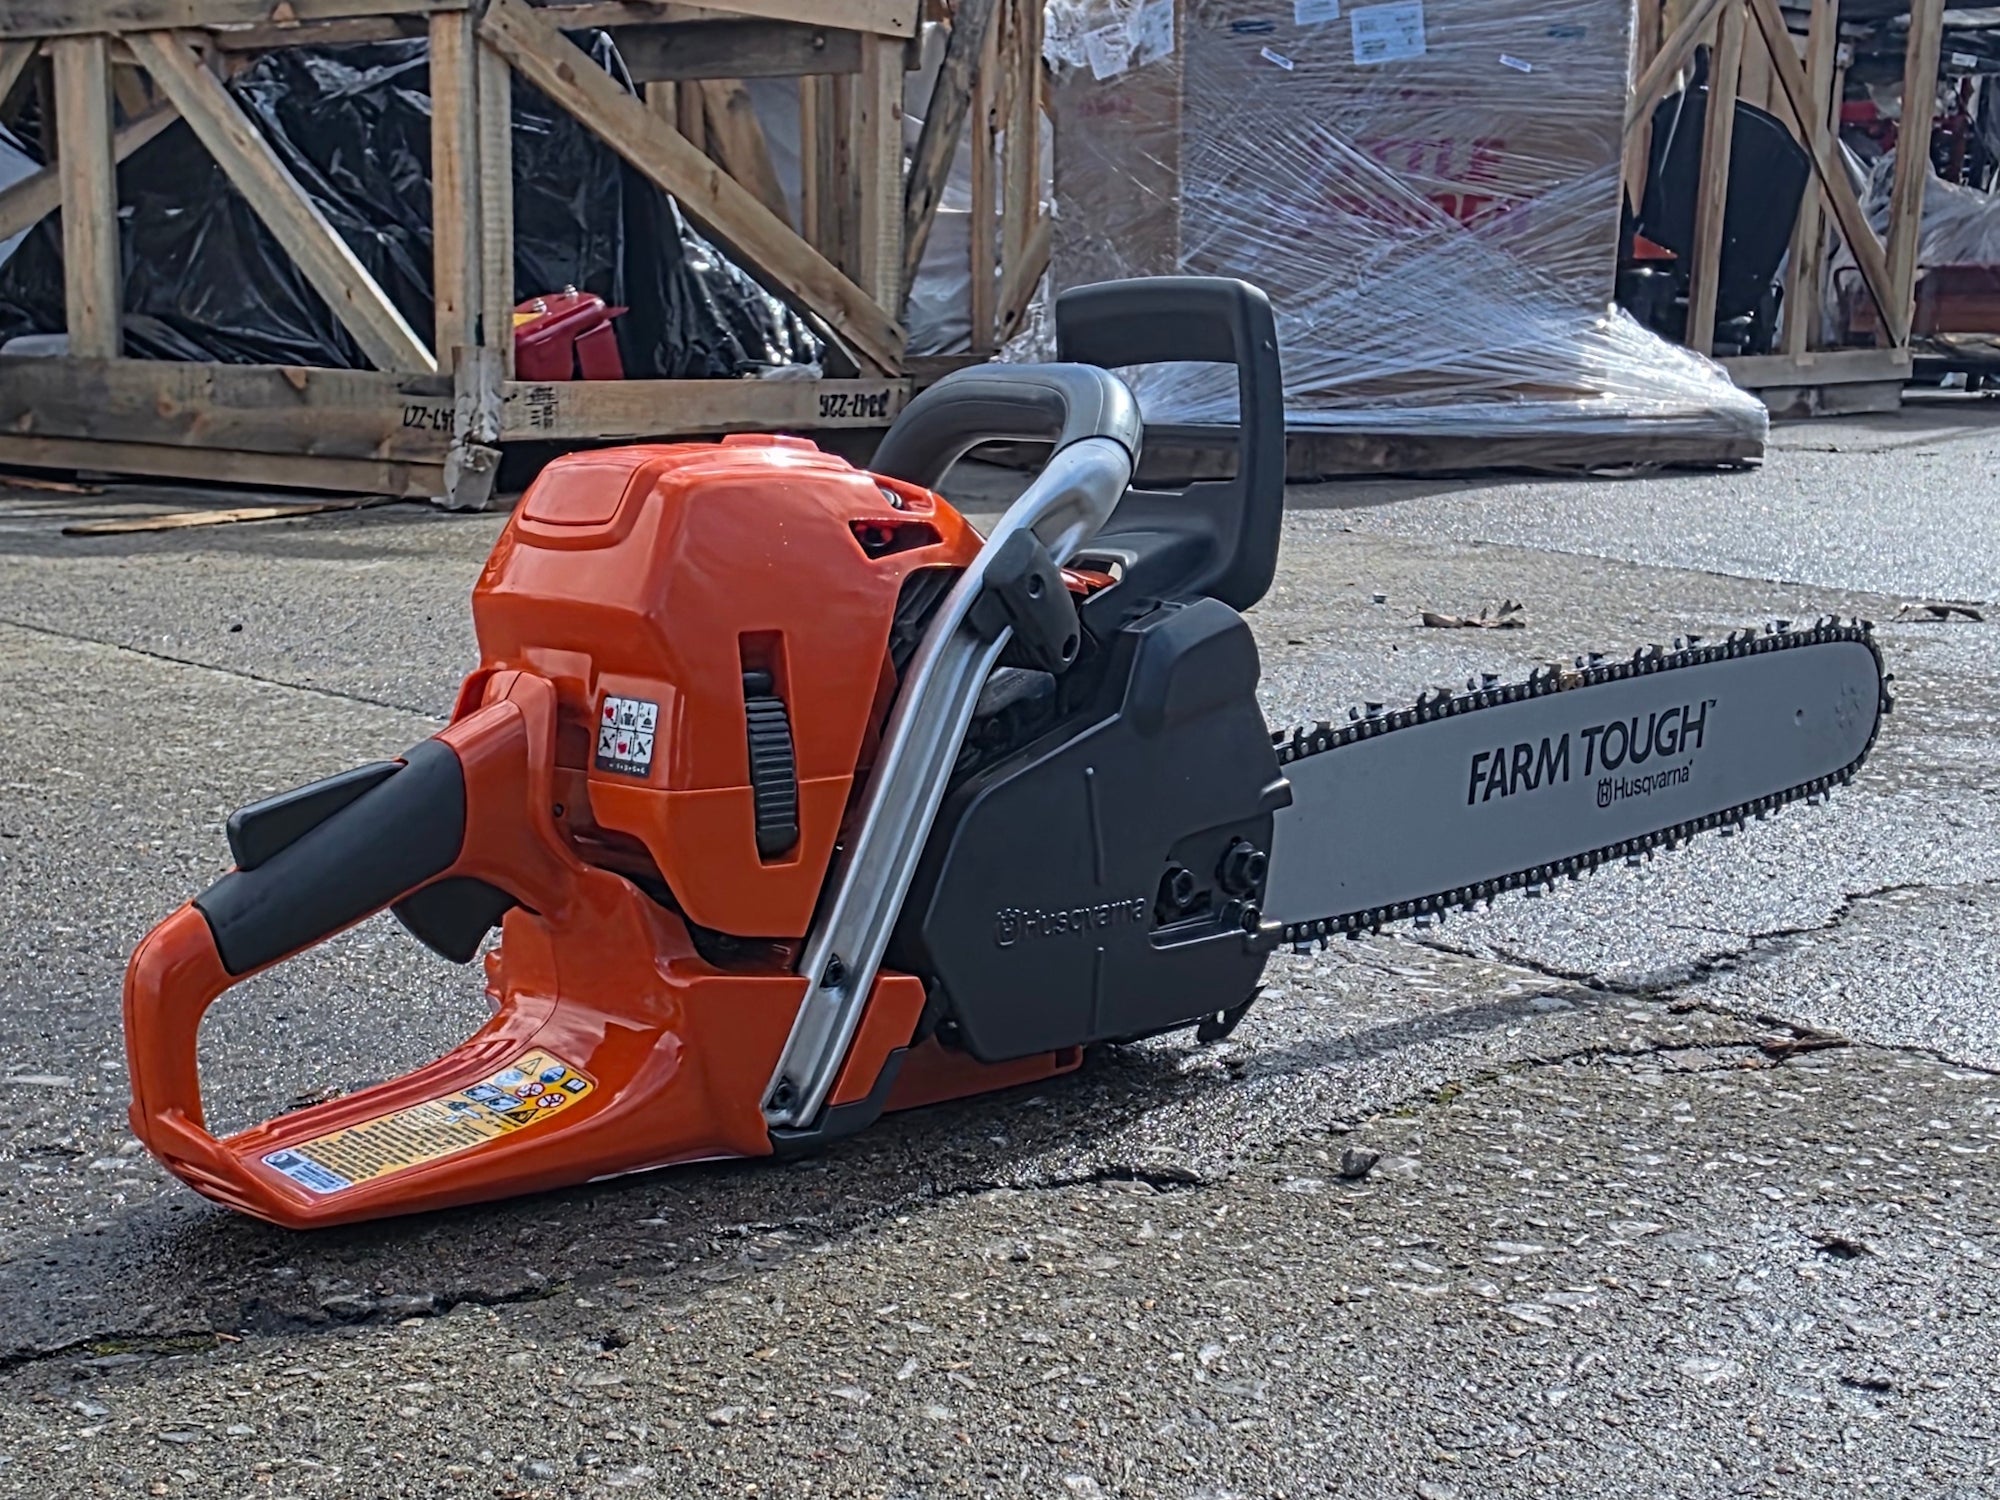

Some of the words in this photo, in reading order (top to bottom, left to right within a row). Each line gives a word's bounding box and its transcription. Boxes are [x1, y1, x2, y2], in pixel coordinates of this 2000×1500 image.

[1467, 733, 1570, 805] FARM
[1613, 764, 1690, 801] Husqvarna
[1023, 896, 1147, 938] Husqvarna
